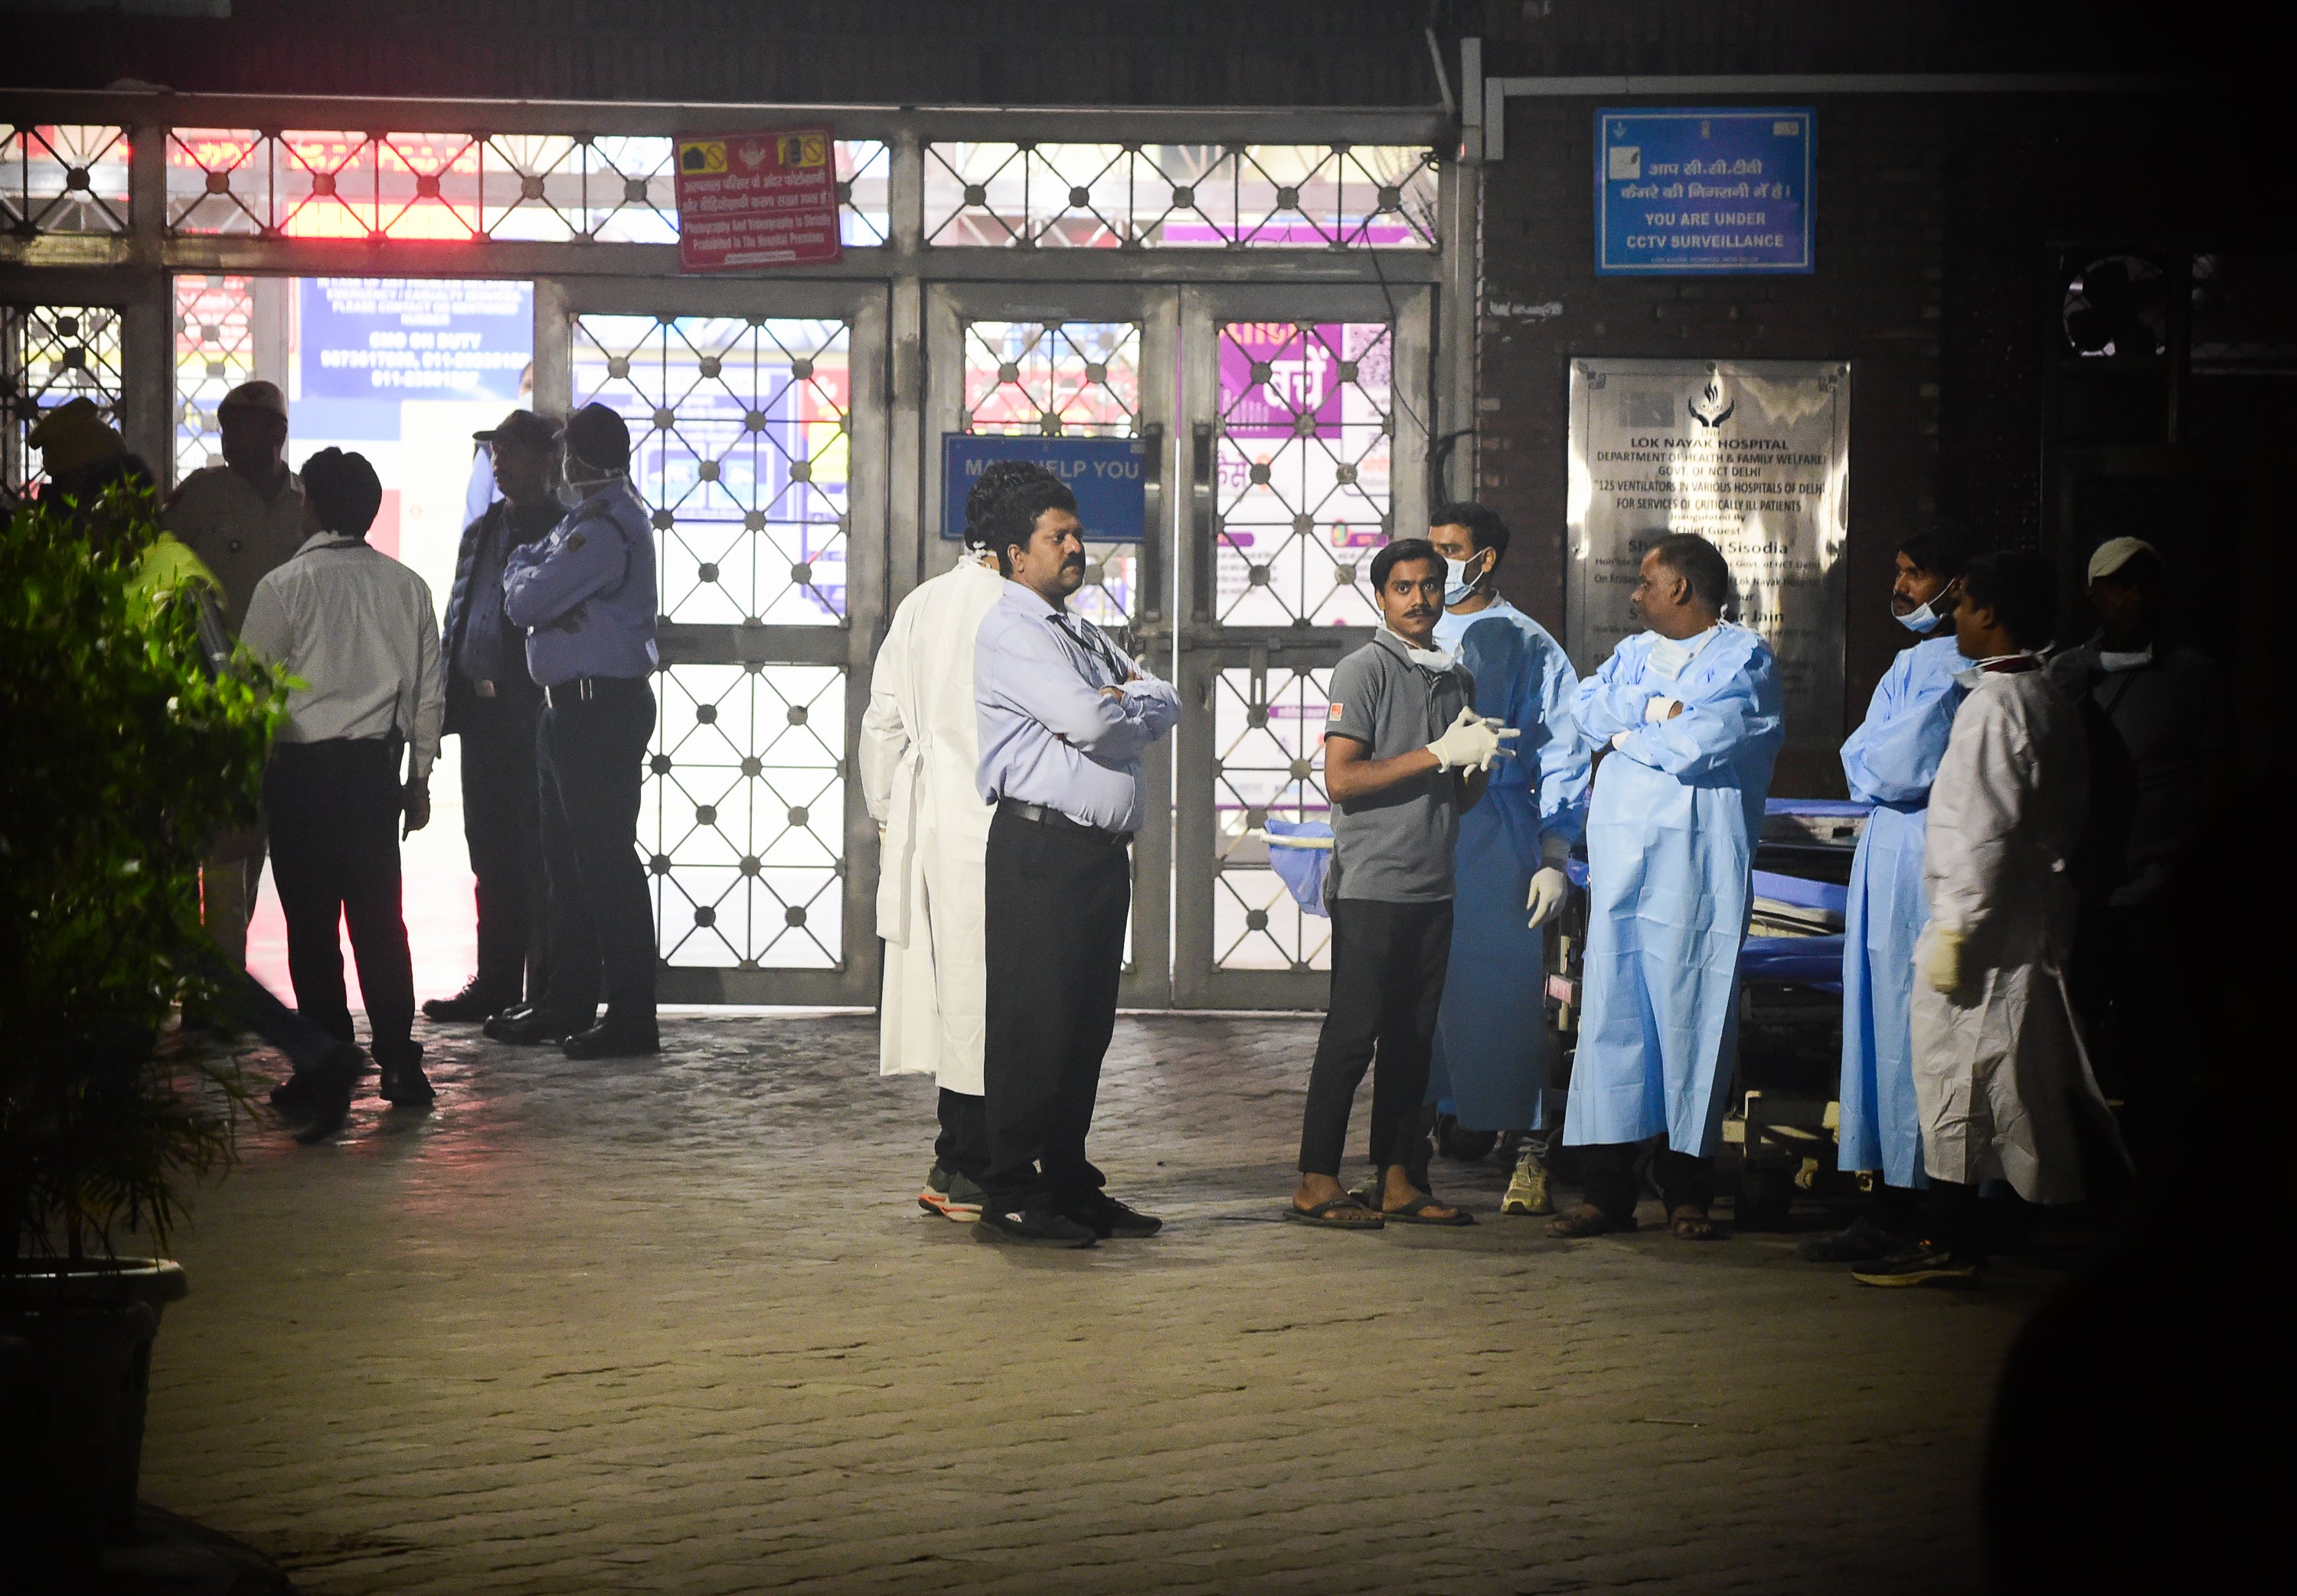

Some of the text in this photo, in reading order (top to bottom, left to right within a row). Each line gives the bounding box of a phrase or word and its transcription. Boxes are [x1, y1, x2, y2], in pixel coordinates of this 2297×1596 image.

[1645, 211, 1766, 226] YOU ARE UNDER
[1626, 234, 1785, 249] CCTV SURVEILLANCE
[1632, 437, 1789, 450] LOK NAYAK HOSPITAL
[1597, 451, 1666, 462] DEPARTMENT
[1668, 452, 1682, 462] OF
[1685, 452, 1724, 462] HEALTH
[1726, 454, 1735, 462] &
[1737, 454, 1774, 464] FAMILY
[1031, 460, 1086, 478] ELP
[1093, 461, 1139, 479] YOU
[1692, 467, 1704, 476] OF
[1708, 467, 1727, 476] NCT
[1732, 467, 1761, 477] DELHI
[1617, 480, 1676, 492] VENTILATORS
[1679, 481, 1689, 492] IN
[1691, 481, 1732, 492] VARIOUS
[1734, 482, 1782, 494] HOSPITALS
[1784, 483, 1796, 494] OF
[1617, 498, 1802, 512] FOR SERVICES OF CRITICALLY ILL PATIENTS
[1670, 513, 1746, 524] Inaugurated By
[1675, 525, 1740, 535] Chief Guest
[1728, 541, 1789, 554] Sisodia
[1595, 574, 1608, 583] On
[1753, 578, 1780, 588] Nayak
[1751, 610, 1784, 622] Jain
